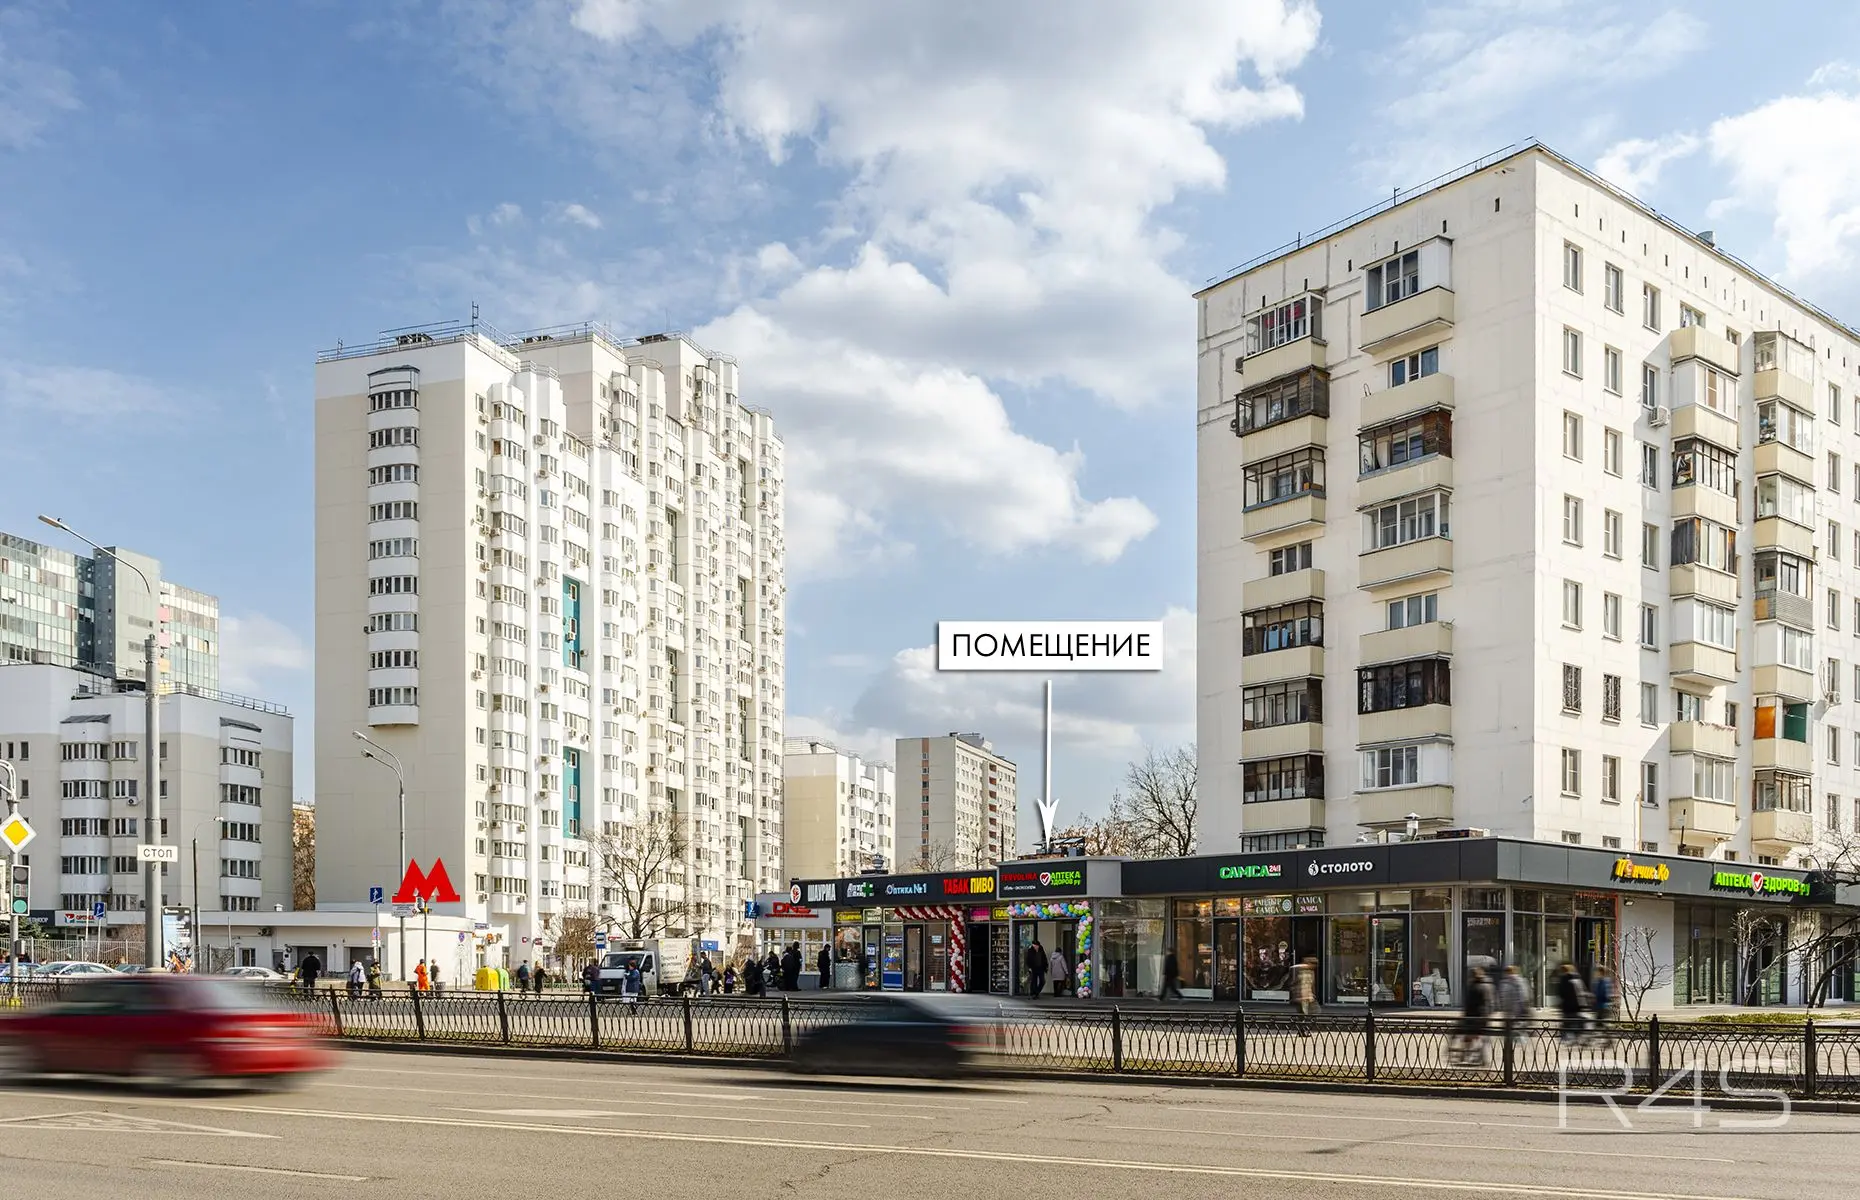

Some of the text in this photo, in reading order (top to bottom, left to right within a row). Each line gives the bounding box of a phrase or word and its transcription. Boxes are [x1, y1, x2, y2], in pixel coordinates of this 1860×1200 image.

[143, 848, 173, 858] СТОП
[1219, 865, 1269, 879] САМСА
[1320, 861, 1374, 874] СТОЛОТО
[1050, 871, 1081, 880] АПТЕКА
[1715, 871, 1751, 888] АПТЕКА
[943, 876, 994, 895] ТАБАК ПИВО
[807, 883, 837, 902] ШАУРМА
[1296, 896, 1322, 904] САМСА
[772, 902, 812, 914] DNS
